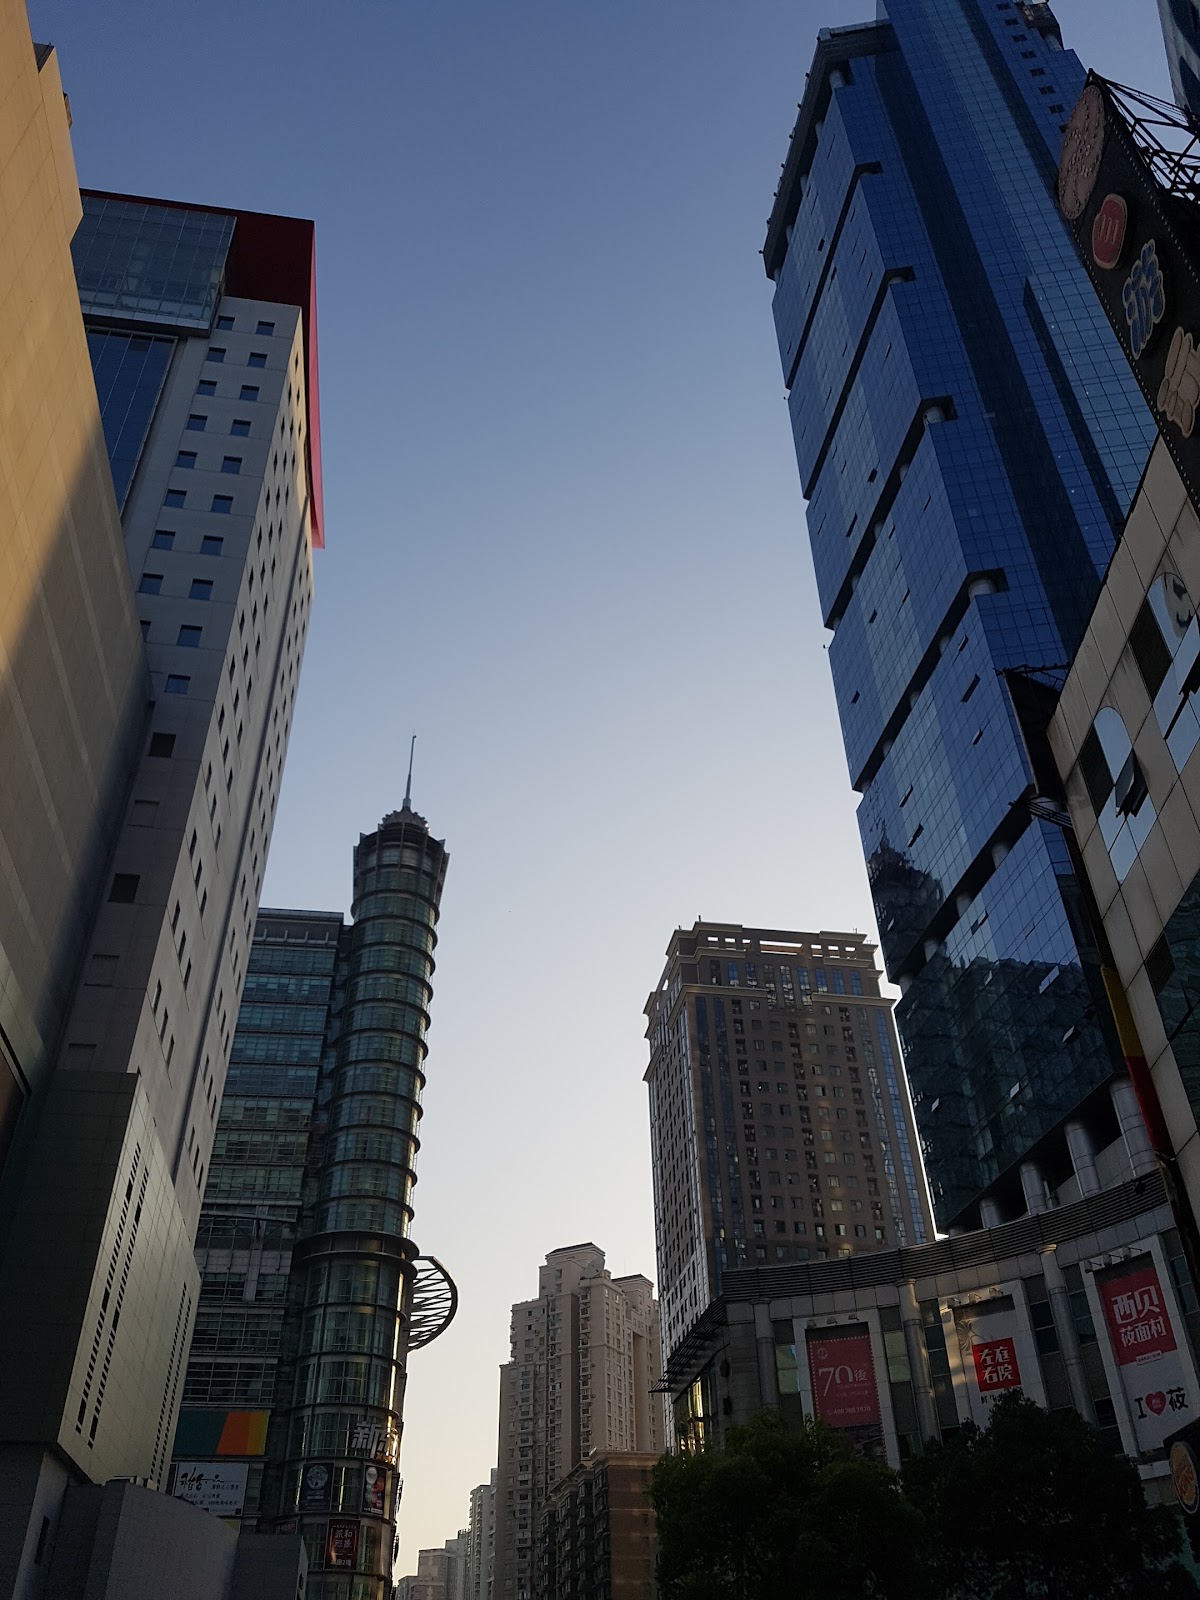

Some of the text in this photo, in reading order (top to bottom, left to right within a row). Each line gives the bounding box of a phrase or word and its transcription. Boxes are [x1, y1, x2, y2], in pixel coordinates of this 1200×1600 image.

[1111, 1285, 1161, 1325] 西贝
[1119, 1315, 1167, 1347] 莜面村
[978, 1345, 1011, 1366] 左庭
[981, 1363, 1015, 1384] 右院
[1134, 1396, 1147, 1419] I
